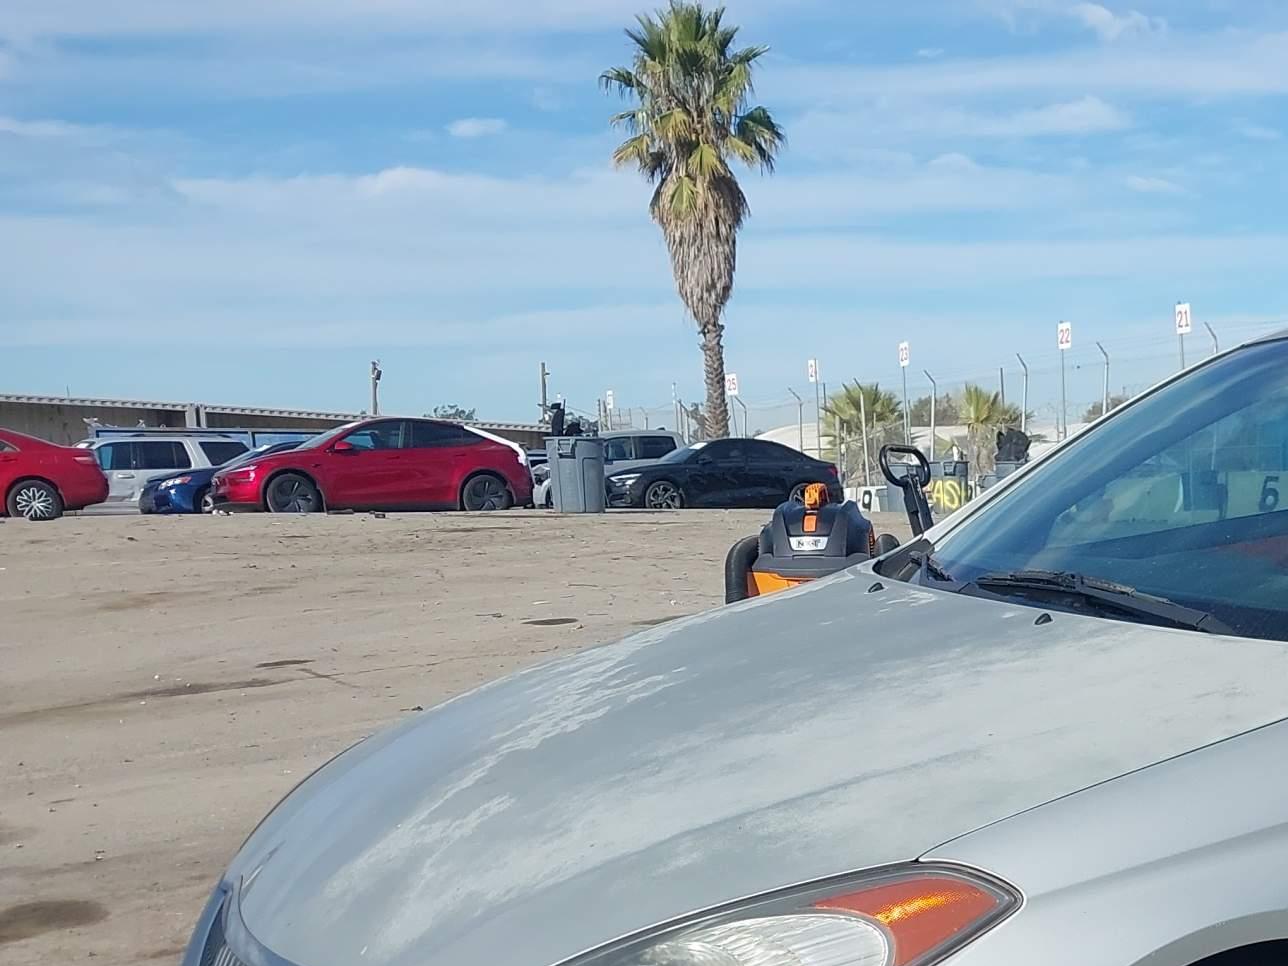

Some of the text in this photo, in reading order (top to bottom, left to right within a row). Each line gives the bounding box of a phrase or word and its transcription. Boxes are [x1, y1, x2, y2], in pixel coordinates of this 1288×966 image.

[1177, 309, 1189, 328] 21
[1059, 327, 1071, 344] 22
[726, 378, 737, 391] 25
